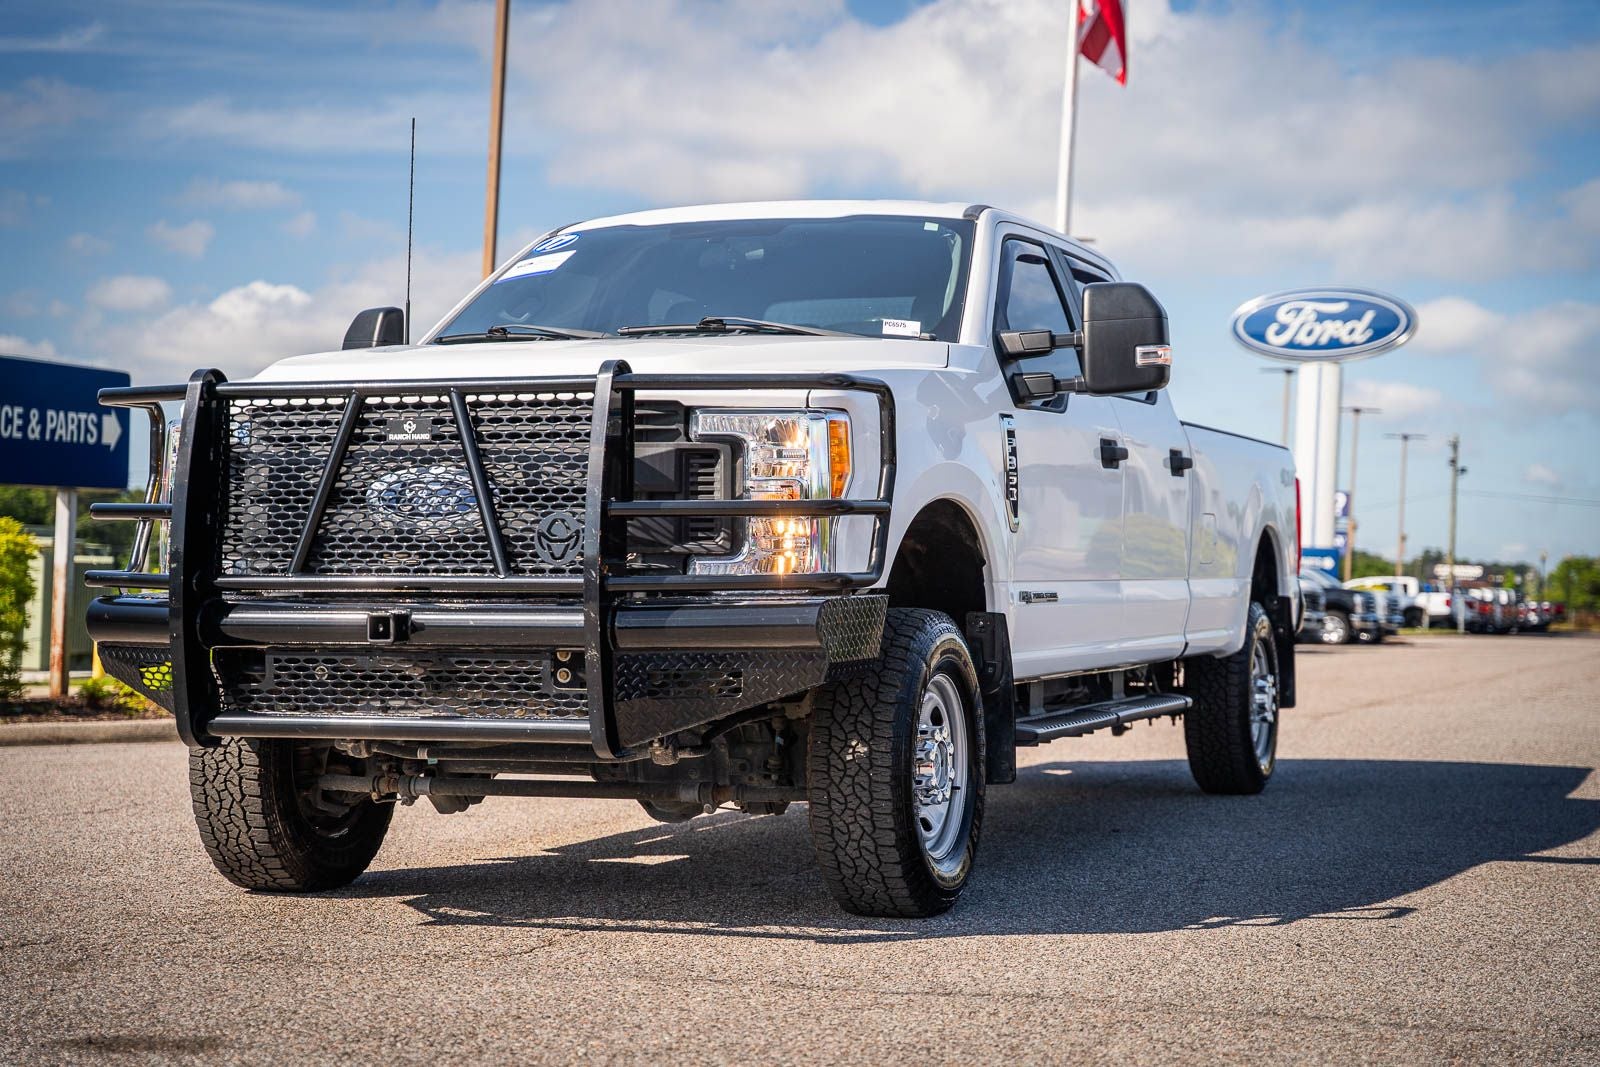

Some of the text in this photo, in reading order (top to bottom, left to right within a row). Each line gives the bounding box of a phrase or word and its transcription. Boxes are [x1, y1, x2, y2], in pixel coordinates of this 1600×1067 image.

[1265, 301, 1376, 347] Ford
[27, 407, 42, 440] &
[45, 409, 98, 445] PARTS
